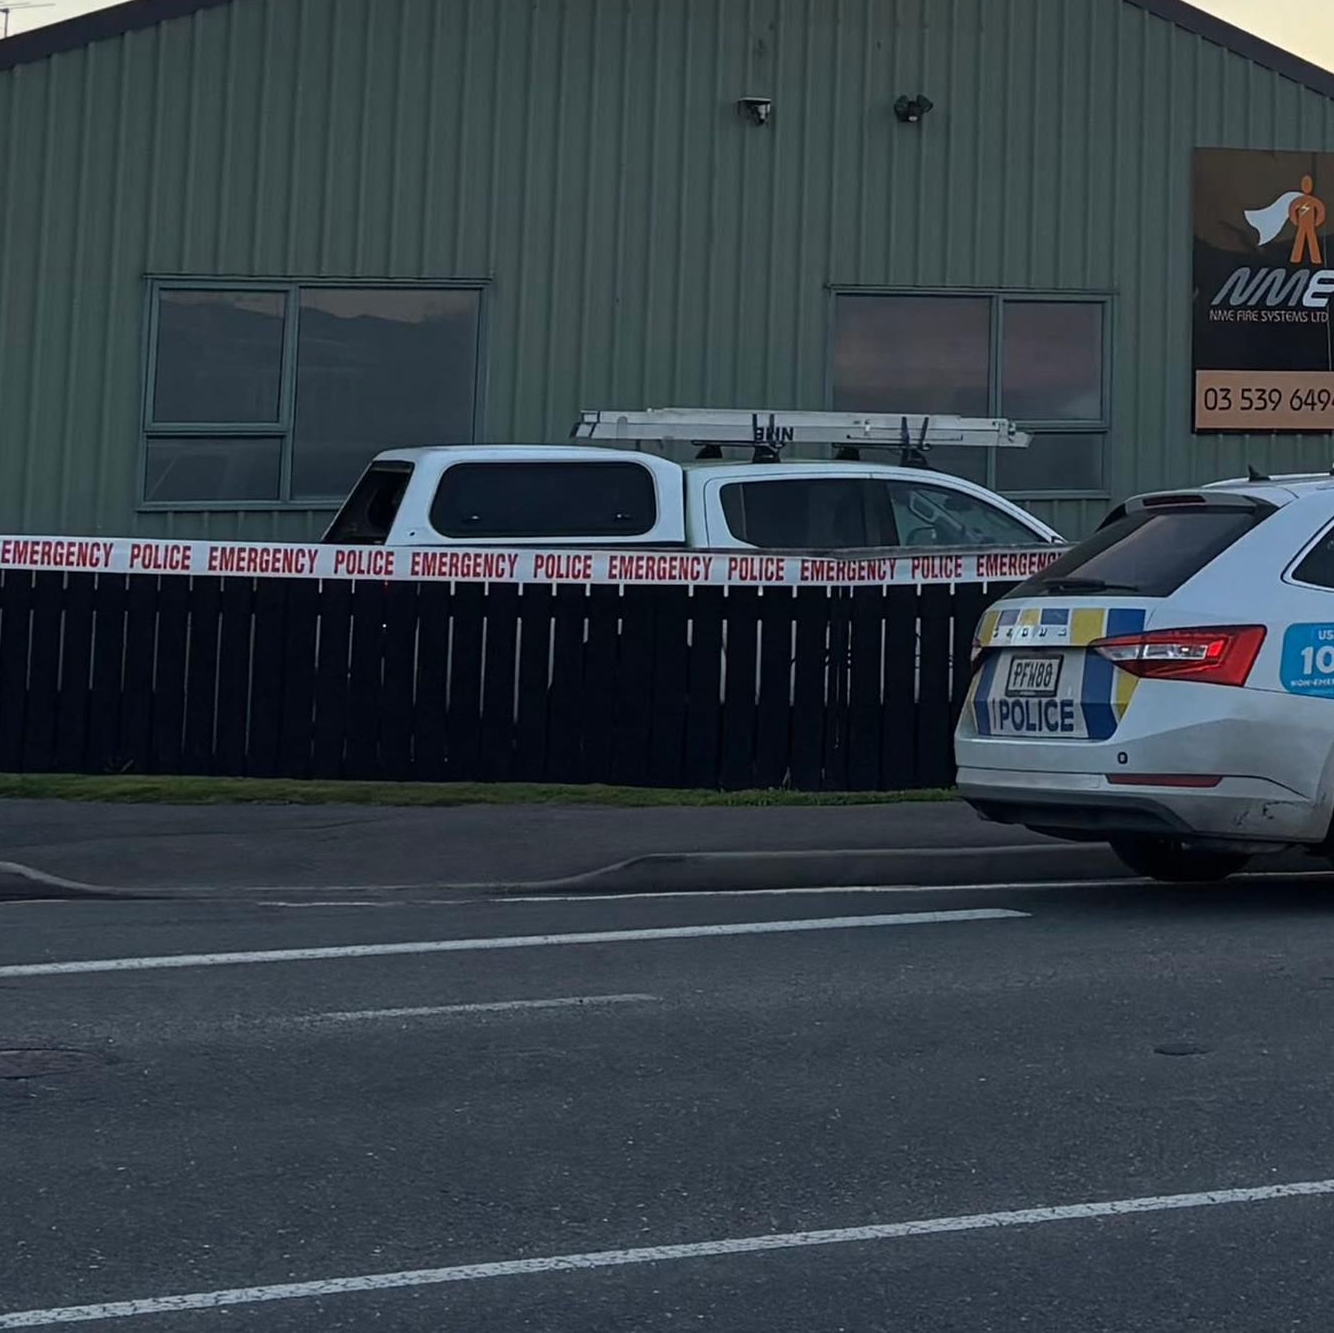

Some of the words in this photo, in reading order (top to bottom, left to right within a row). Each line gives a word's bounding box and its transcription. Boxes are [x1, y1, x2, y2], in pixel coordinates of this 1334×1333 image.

[1209, 309, 1235, 321] NME
[1237, 310, 1260, 322] FIRE
[1261, 311, 1308, 322] SYSTEMS
[1310, 312, 1329, 322] LTD
[1204, 388, 1232, 411] 03
[1240, 388, 1282, 411] 539
[0, 540, 114, 568] EMERGENCY
[130, 543, 191, 570] POLICE
[208, 545, 318, 574] EMERGENCY
[334, 549, 394, 576] POLICE
[411, 551, 517, 578] EMERGENCY
[534, 554, 592, 580] POLICE
[608, 555, 712, 581] EMERGENCY
[728, 556, 785, 581] POLICE
[800, 558, 897, 581] EMERGENCY
[911, 555, 962, 579] POLICE
[976, 552, 1062, 577] EMERGEN
[999, 699, 1074, 732] POLICE
